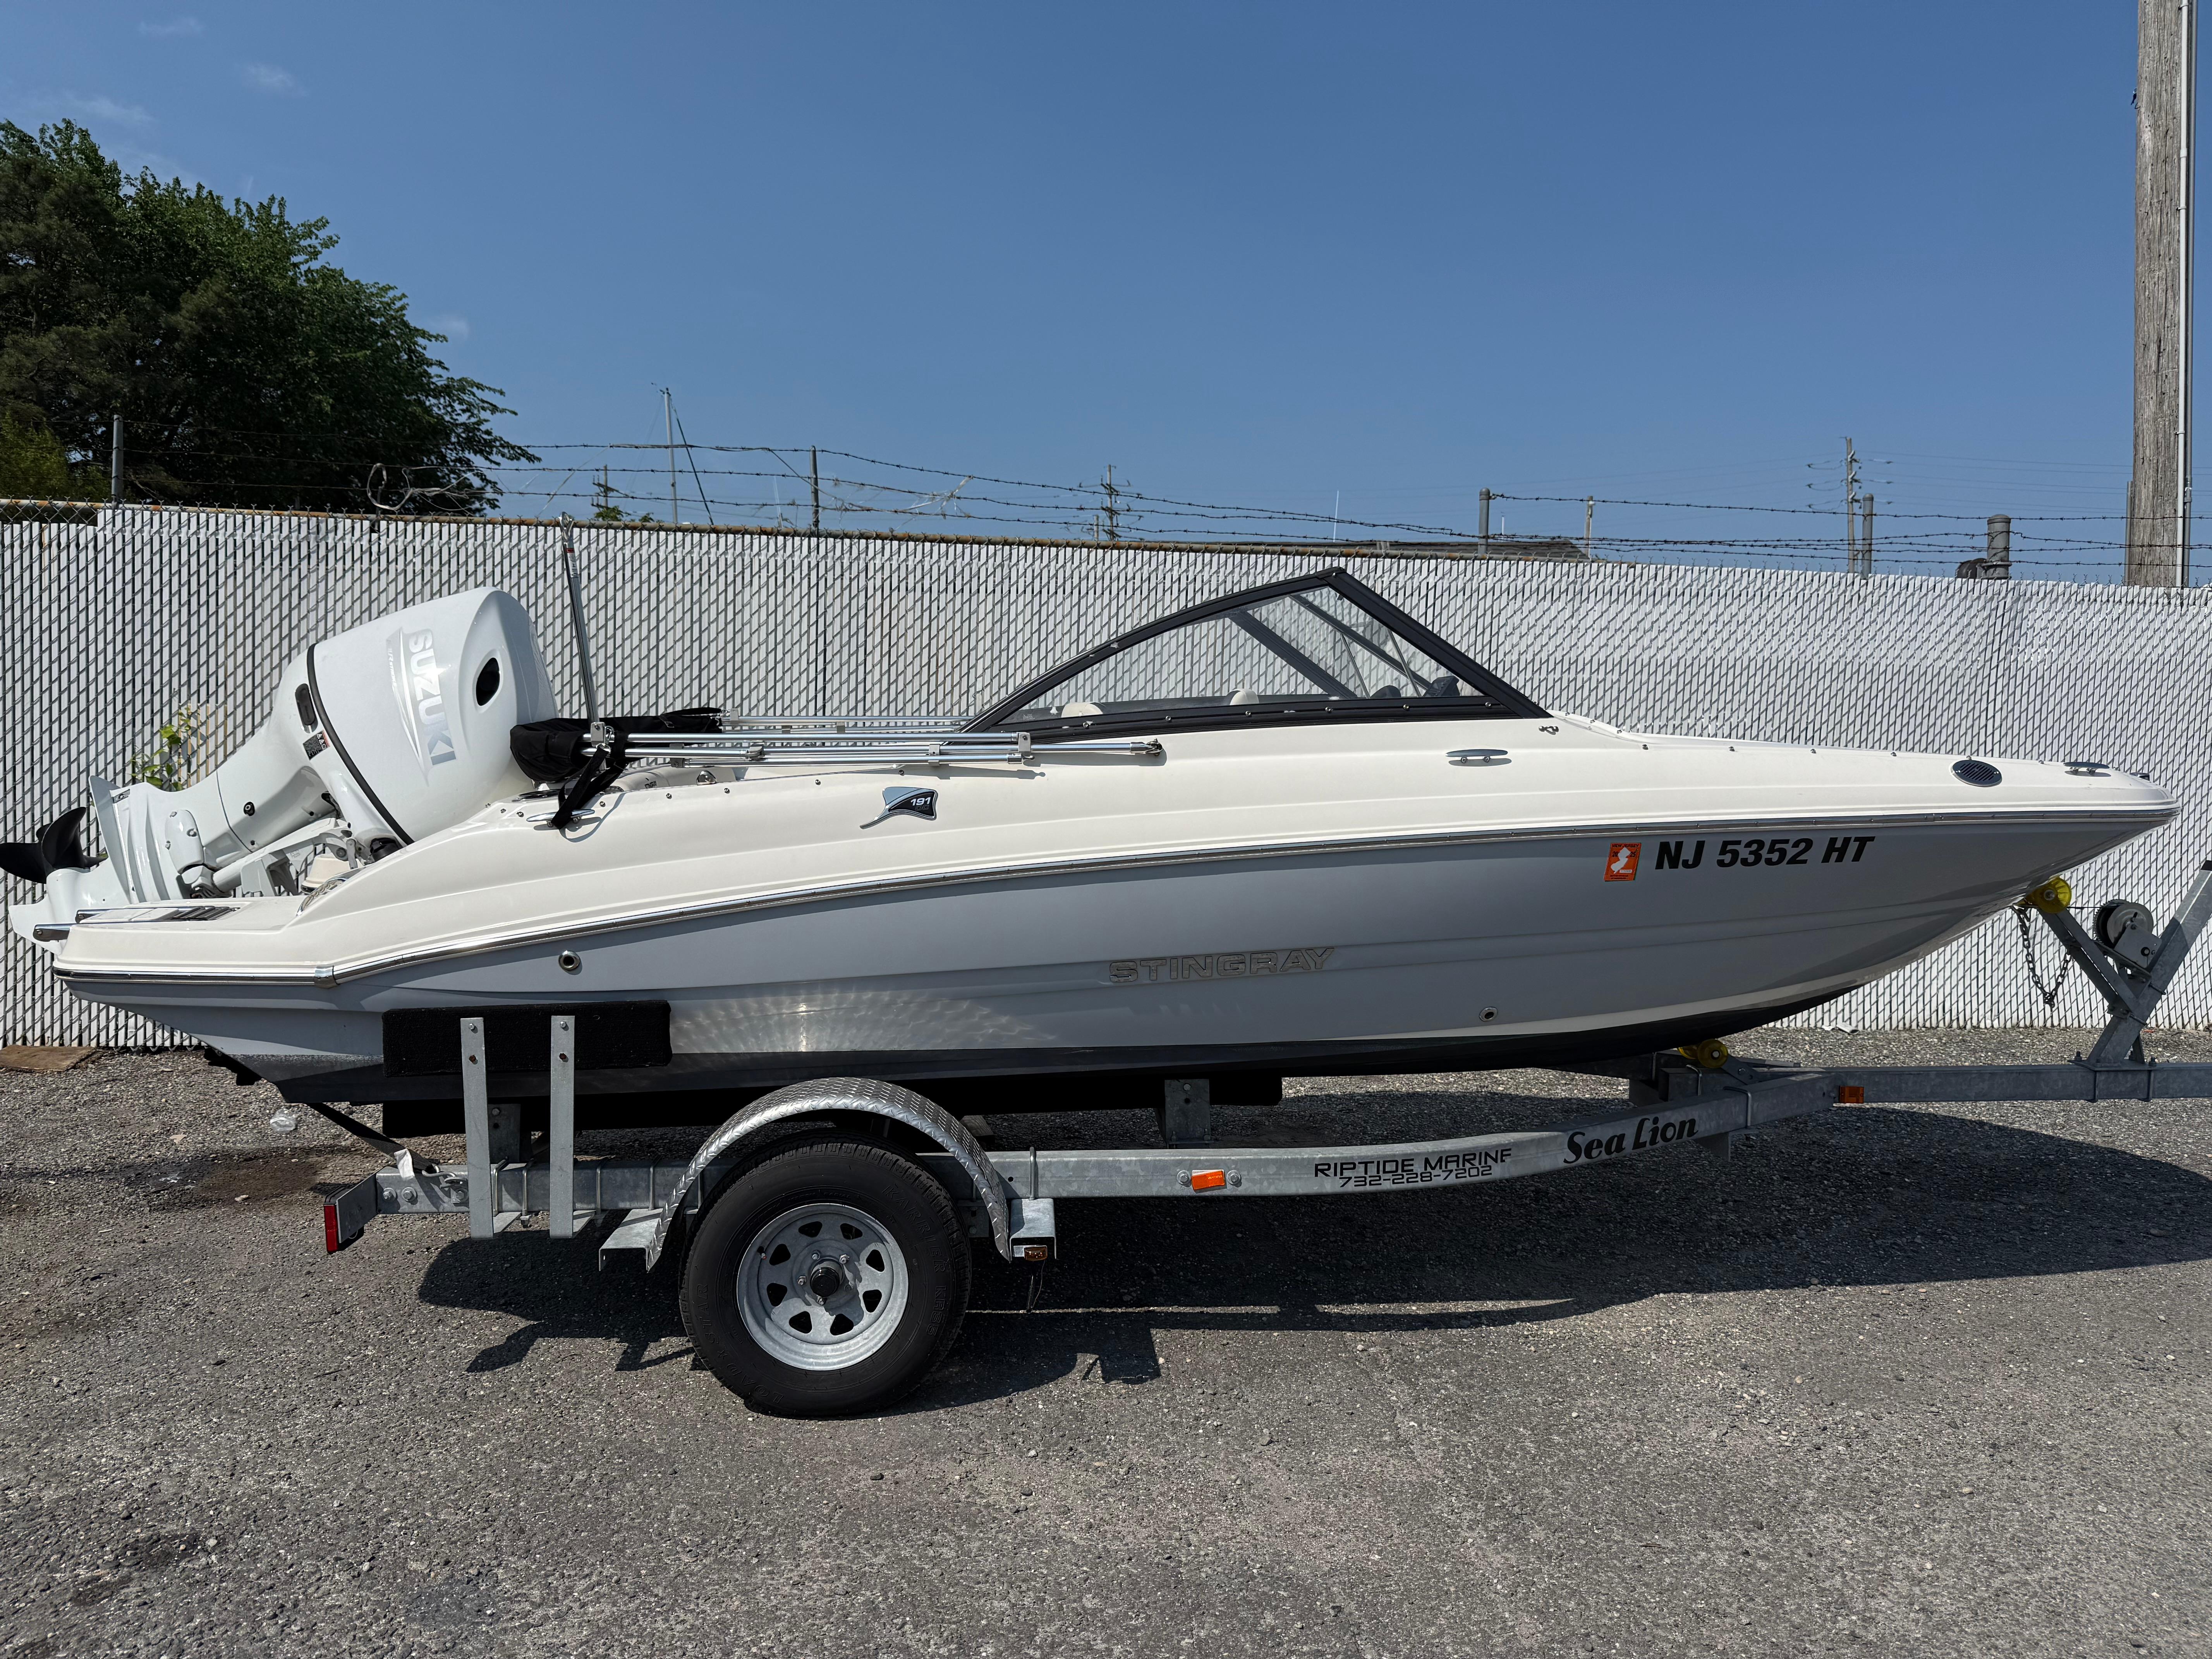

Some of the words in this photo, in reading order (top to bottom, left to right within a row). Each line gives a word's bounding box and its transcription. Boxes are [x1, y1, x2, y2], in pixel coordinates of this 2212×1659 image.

[409, 628, 456, 766] SUZUKI
[911, 797, 931, 806] 191
[1655, 840, 1705, 870] NJ
[1716, 838, 1814, 867] 5352
[1821, 836, 1876, 864] HT
[1109, 948, 1335, 982] STINGRAY
[1563, 1131, 1626, 1164] Sea
[1632, 1116, 1699, 1151] Lion
[1314, 1158, 1415, 1178] RIPTIDE
[1339, 1165, 1492, 1188] 732-228-7202
[882, 1185, 946, 1273] KARRIER
